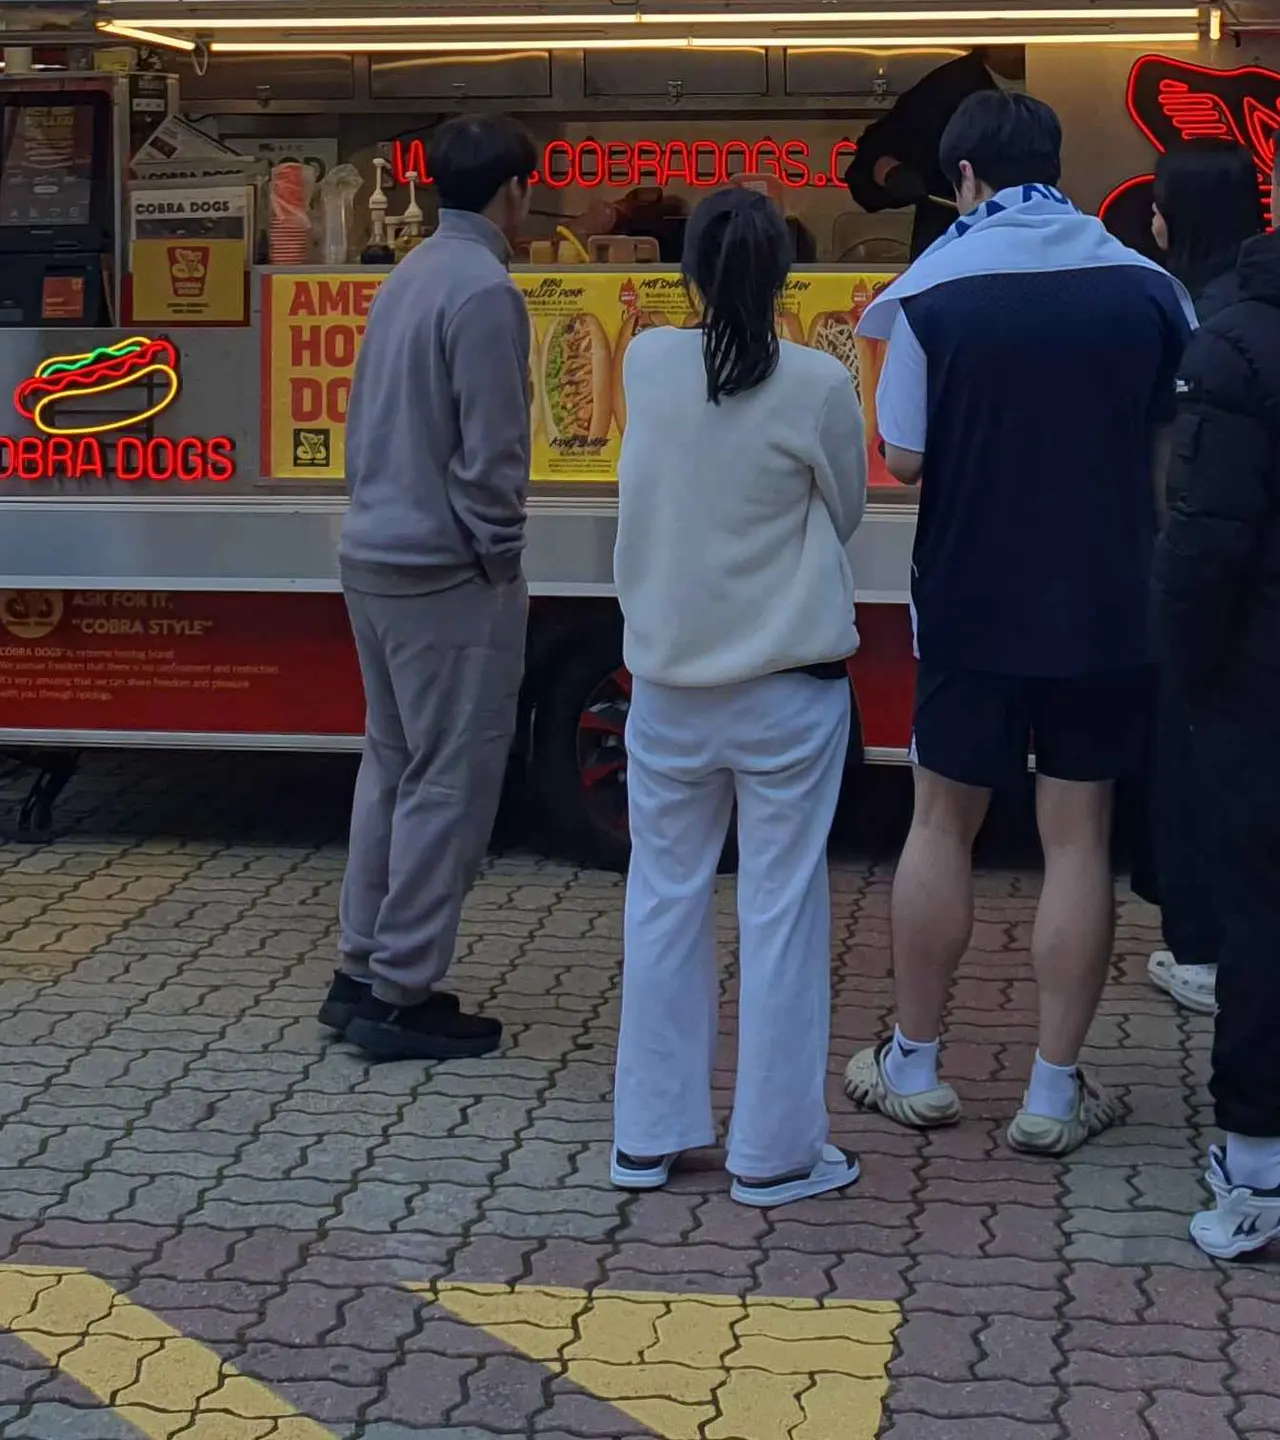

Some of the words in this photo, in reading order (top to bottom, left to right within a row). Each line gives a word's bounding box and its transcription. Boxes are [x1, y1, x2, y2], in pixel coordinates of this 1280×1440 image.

[135, 202, 185, 215] COBRA
[190, 201, 230, 214] DOGS
[288, 281, 381, 316] AME
[116, 438, 236, 482] DOGS
[72, 591, 108, 606] ASK
[113, 592, 147, 608] FOR
[0, 647, 32, 657] COBRA
